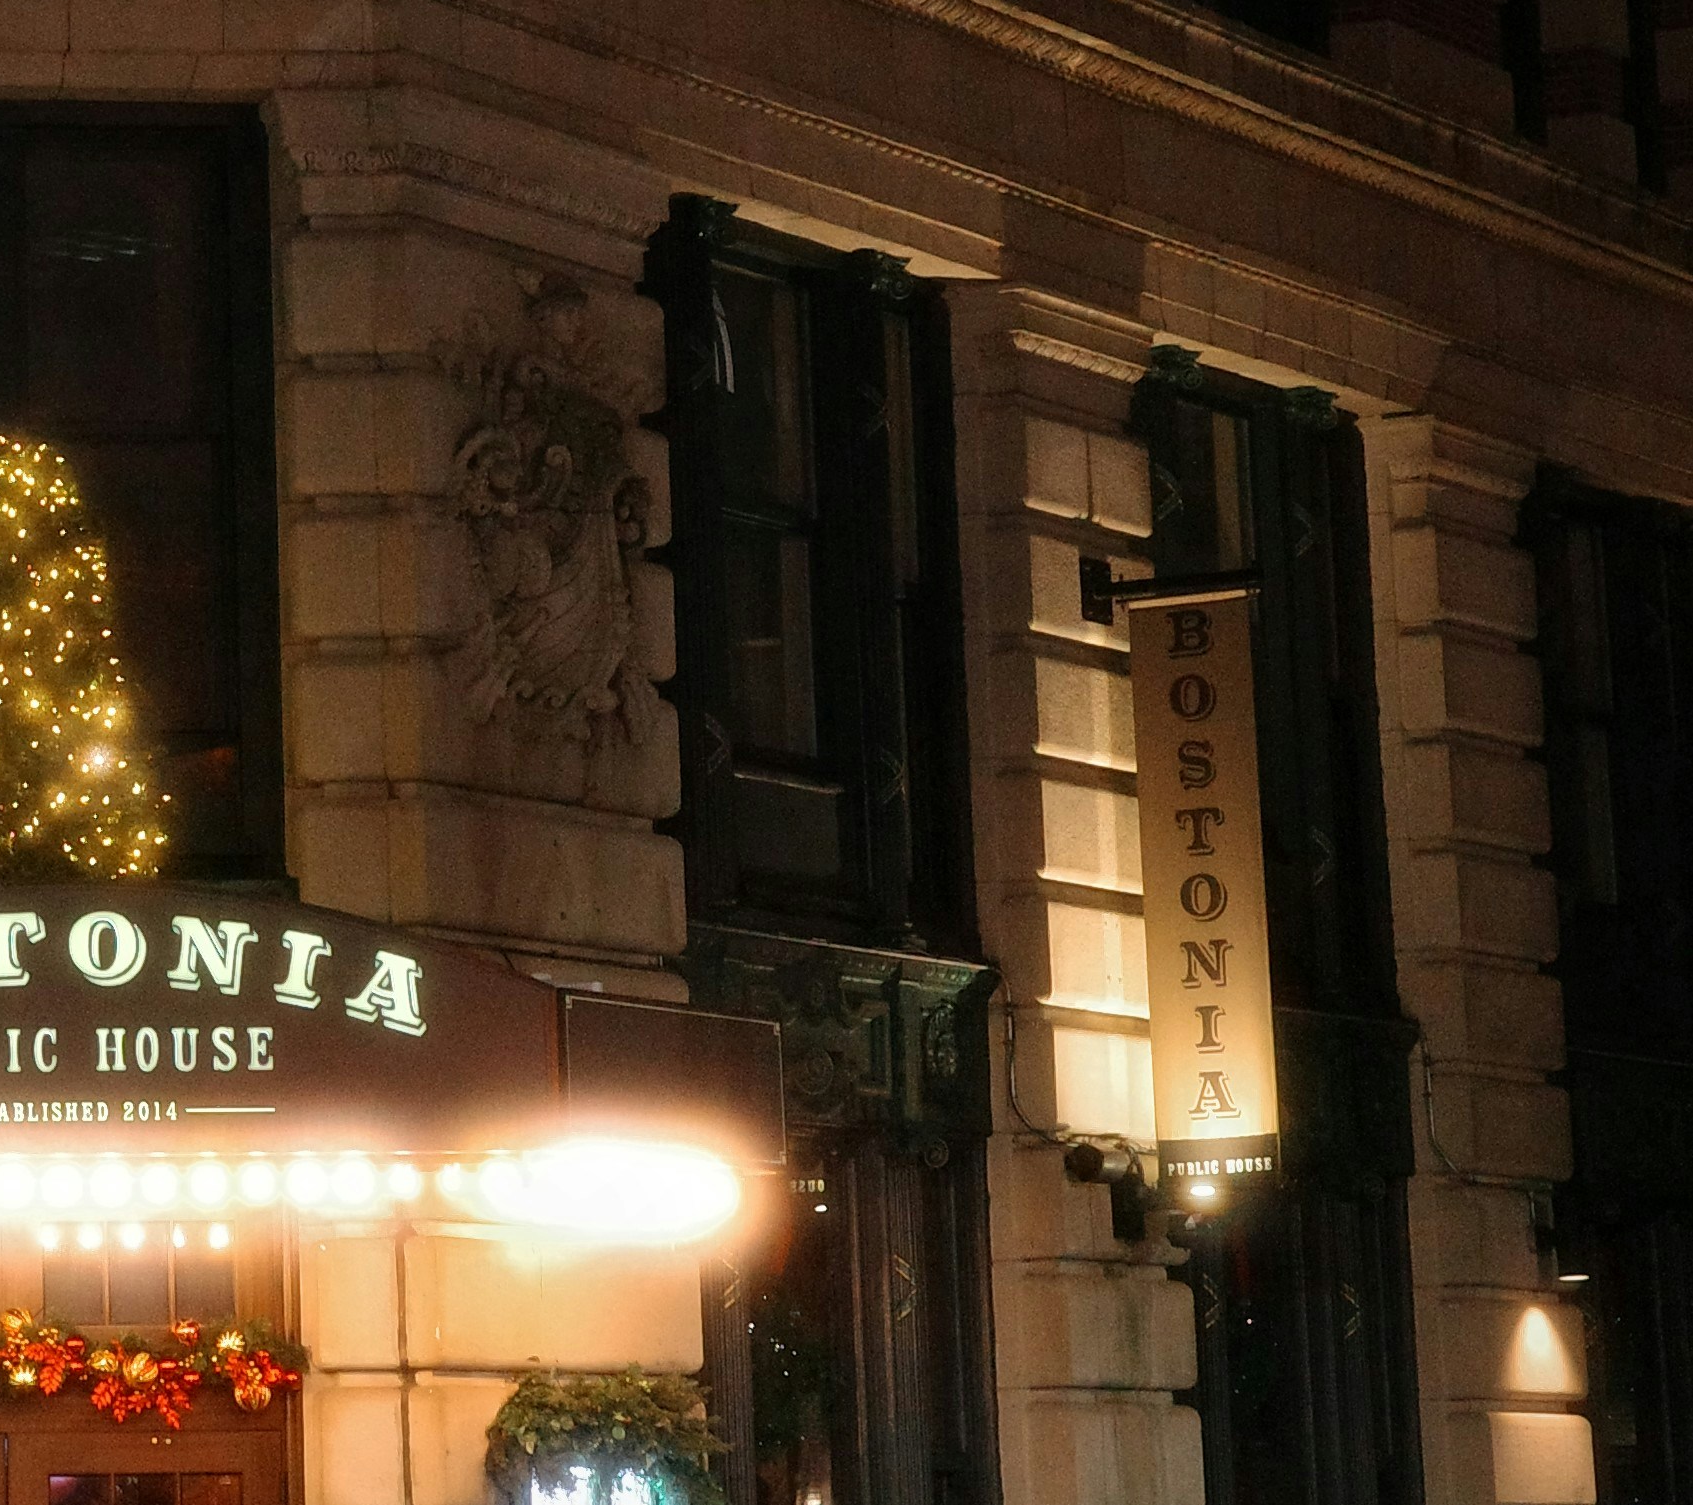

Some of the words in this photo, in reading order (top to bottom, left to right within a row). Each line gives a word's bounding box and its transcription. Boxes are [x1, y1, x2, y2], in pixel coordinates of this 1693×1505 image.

[1167, 609, 1241, 1118] BOSTONIA
[96, 1026, 275, 1071] HOUSE
[123, 1100, 179, 1121] 2014
[1167, 1159, 1219, 1176] PUBLIC
[1225, 1156, 1273, 1174] HOUSE
